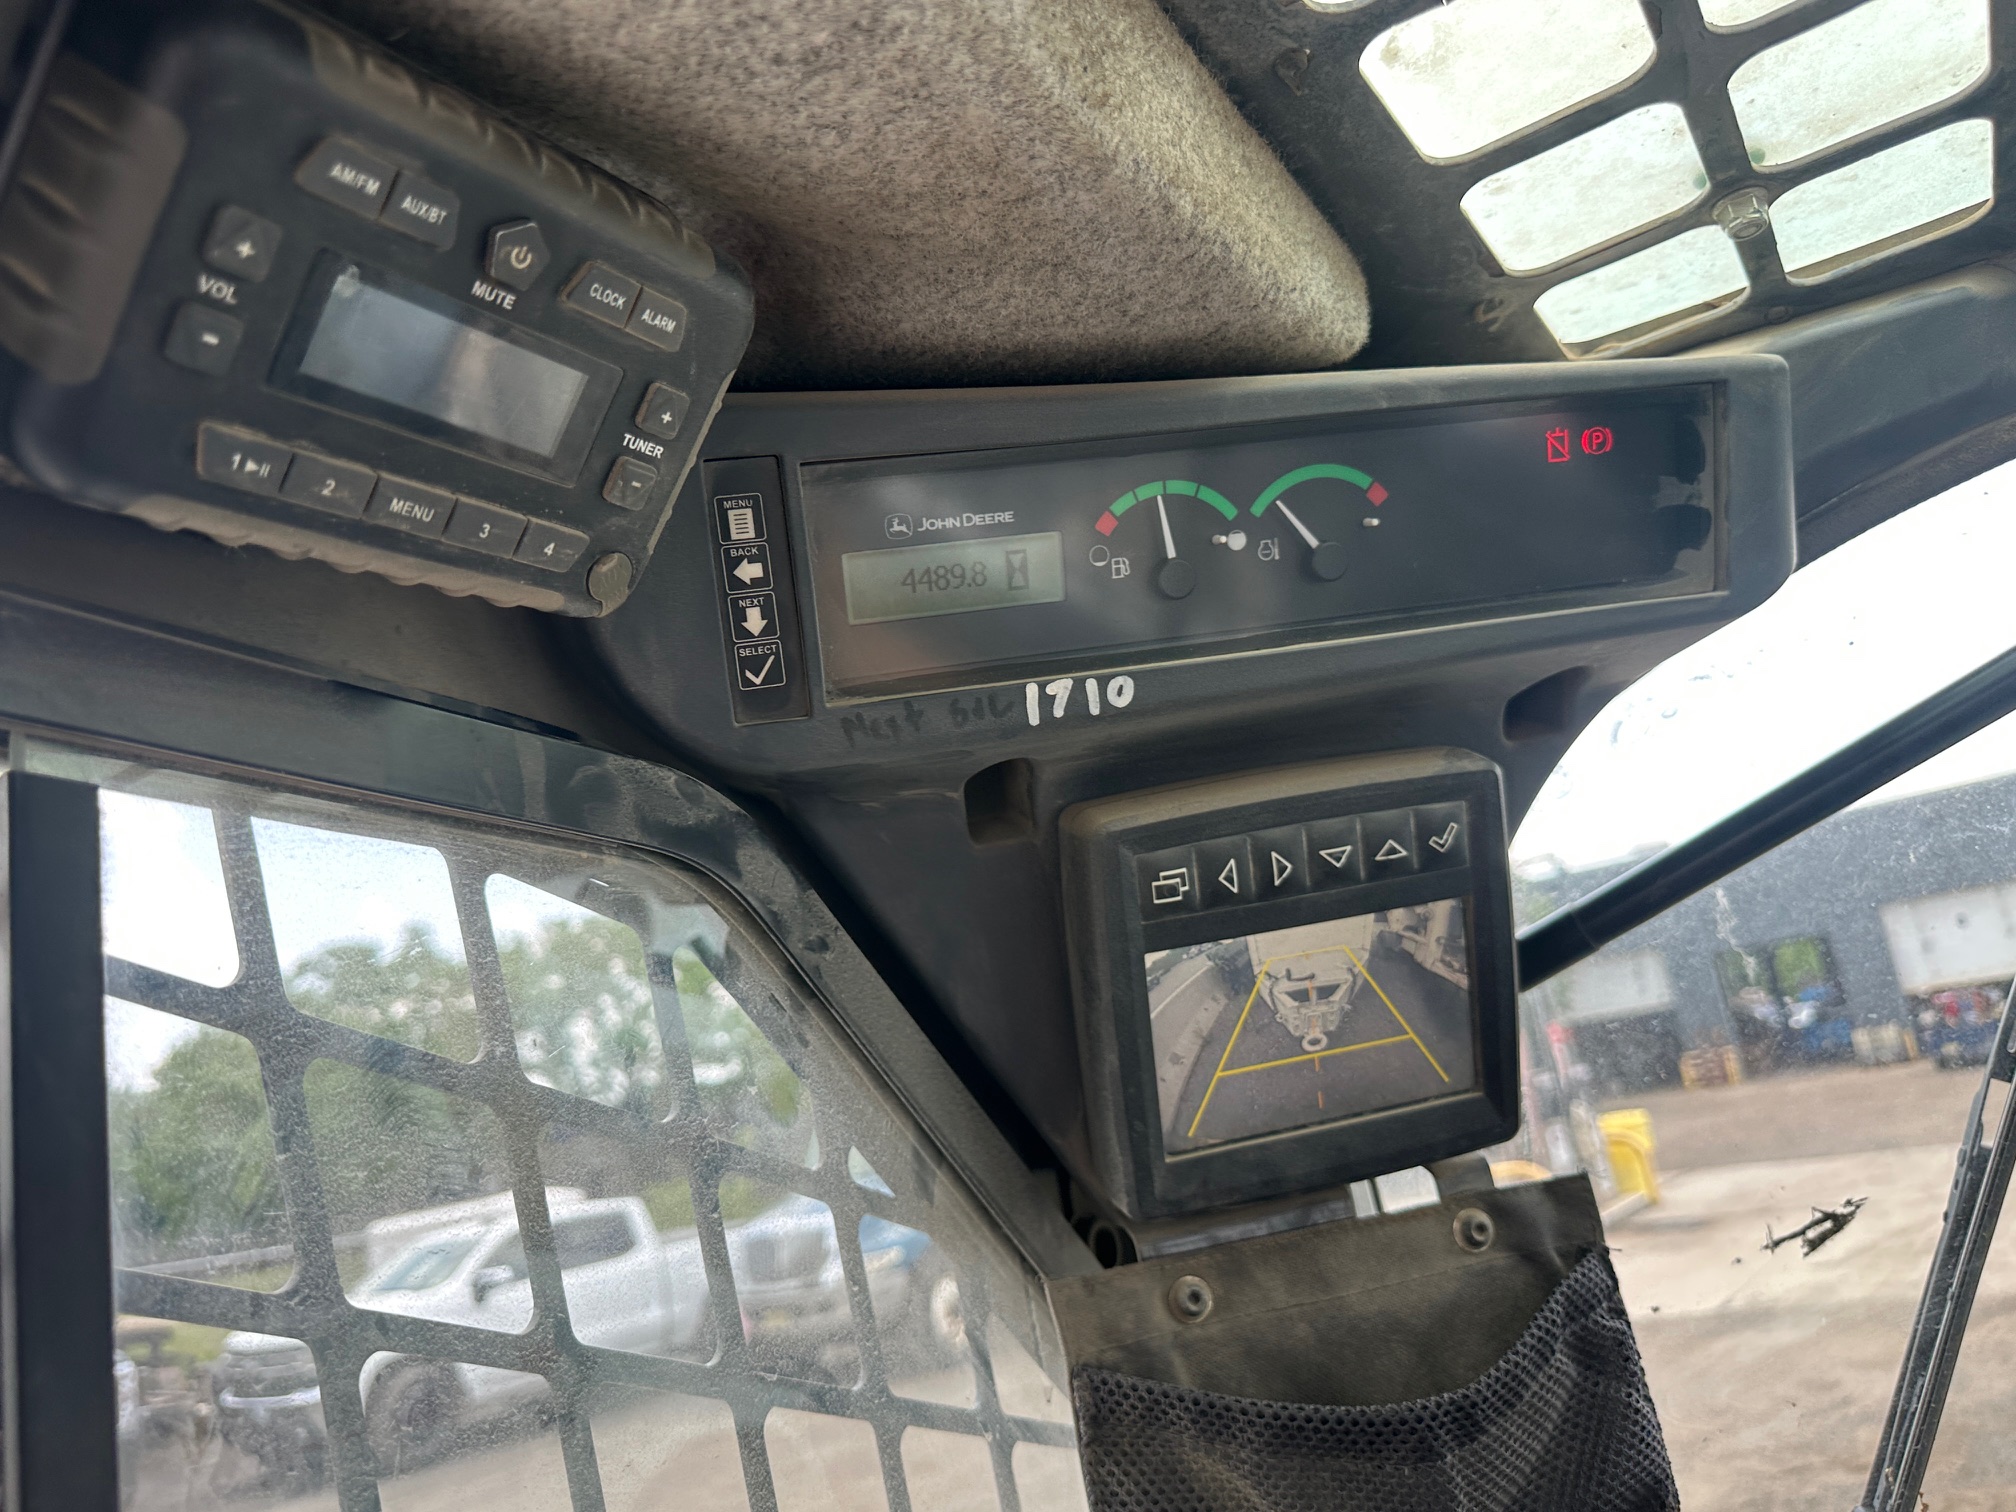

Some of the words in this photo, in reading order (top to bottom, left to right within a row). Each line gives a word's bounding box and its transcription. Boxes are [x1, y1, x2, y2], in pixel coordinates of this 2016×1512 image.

[329, 162, 381, 196] AM/FM
[198, 274, 238, 303] VOL
[471, 280, 517, 310] MUTE
[589, 283, 627, 310] CLOCK
[641, 308, 677, 334] ALARM
[622, 433, 664, 458] TUNER
[232, 453, 242, 471] 1
[321, 478, 336, 496] 2
[389, 497, 436, 522] MENU
[723, 499, 753, 509] MENU
[478, 522, 491, 539] 3
[917, 514, 961, 532] JOHN
[962, 511, 1015, 527] DEERE
[543, 541, 555, 557] 4
[730, 546, 759, 557] BACK
[901, 561, 988, 594] 4489.8
[738, 597, 765, 607] NEXT
[739, 644, 777, 657] SELECT
[1025, 675, 1134, 726] 1710
